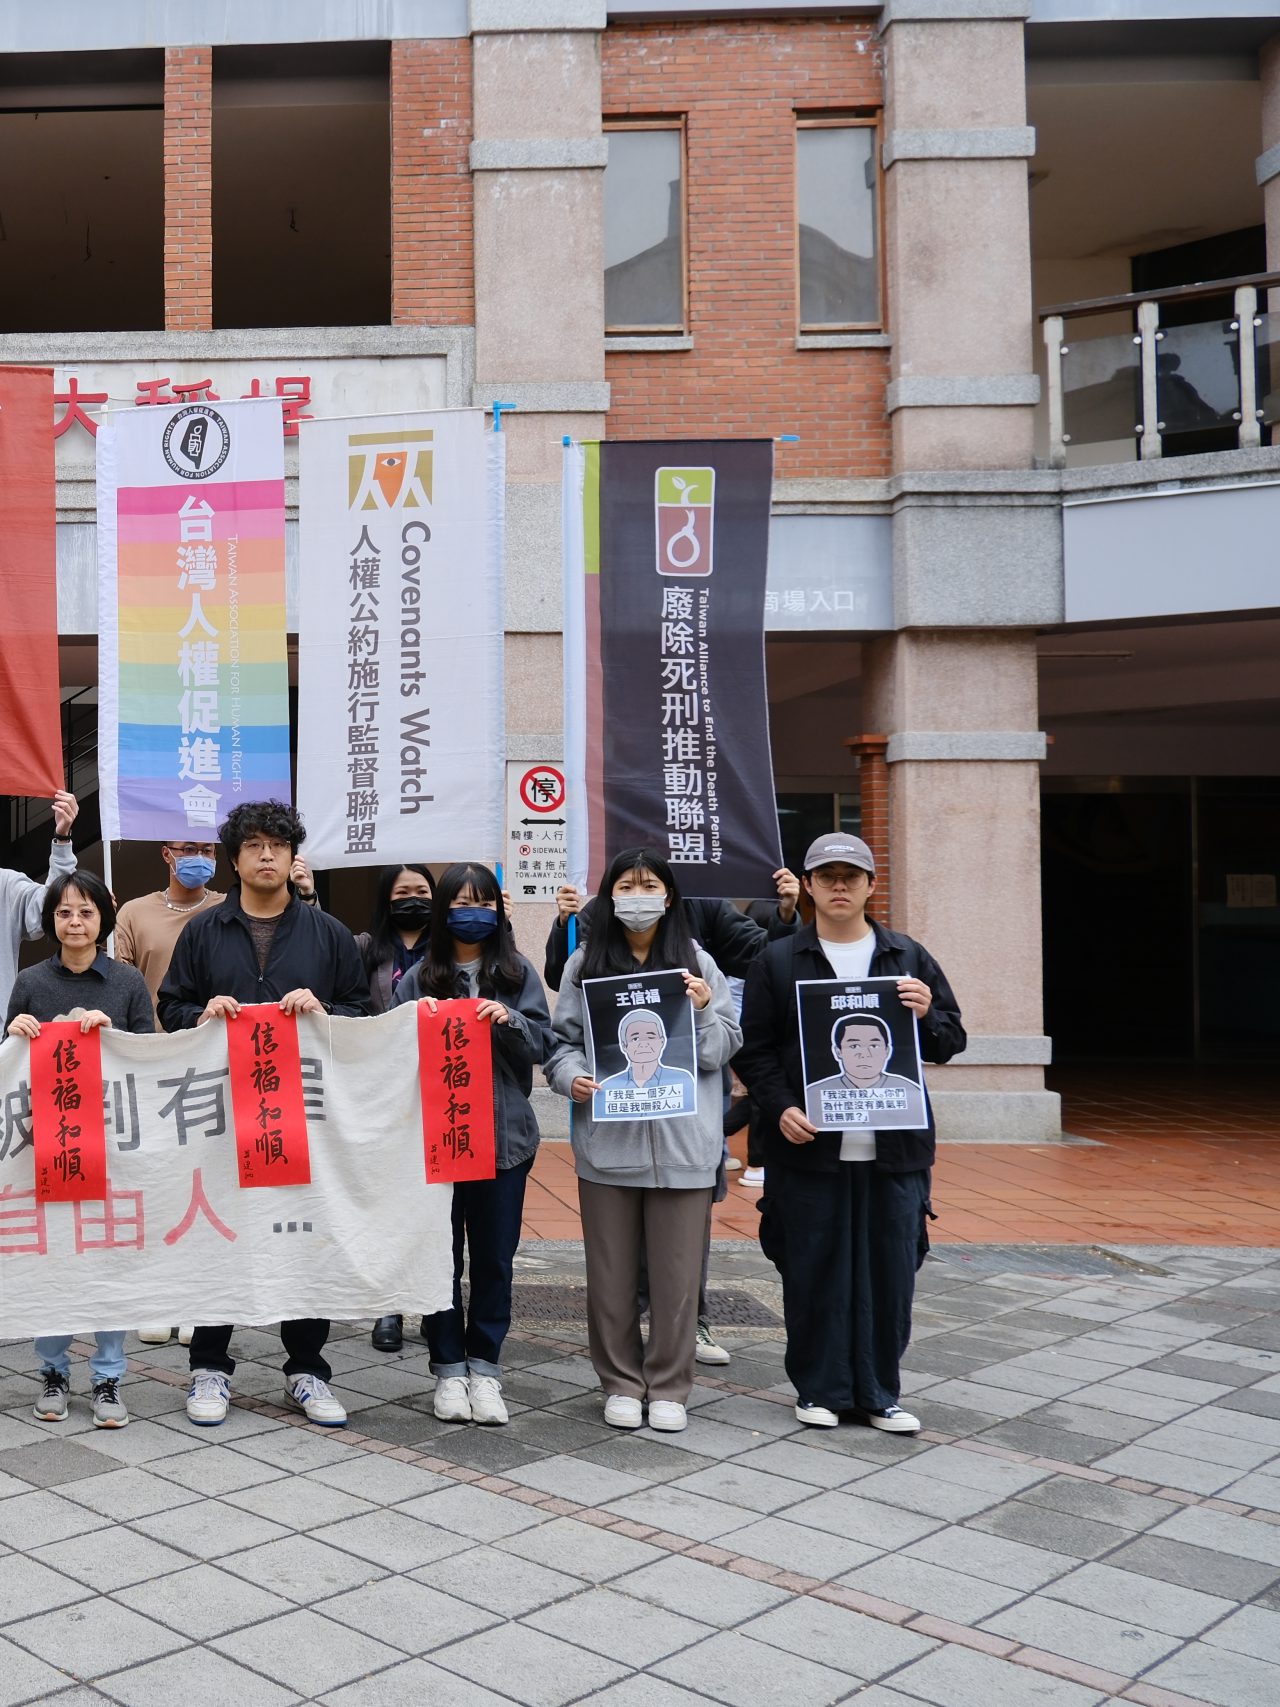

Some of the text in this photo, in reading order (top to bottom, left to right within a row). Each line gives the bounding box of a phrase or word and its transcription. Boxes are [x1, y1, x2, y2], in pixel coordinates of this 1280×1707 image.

[163, 421, 175, 447] RIGHTS
[164, 449, 180, 473] HUMAN
[195, 446, 229, 478] ASSOCIATION
[216, 417, 229, 444] TAIWAN
[176, 495, 223, 829] 台灣人權促進會
[227, 533, 243, 792] TAIWAN ASSOCIATION FOR HUMAN RIGHTS
[343, 524, 382, 855] 人權公約施行監督聯盟
[400, 520, 435, 815] Covenants Watch
[661, 585, 708, 865] 廢除死刑推動聯盟
[698, 587, 723, 865] Taiwan Alliance to End the Death Penalty
[511, 830, 567, 841] 騎樓·人行
[531, 777, 557, 803] 停
[615, 989, 661, 1007] 王信福
[830, 993, 880, 1010] 邱和順
[51, 1039, 86, 1183] 信福和順
[251, 1022, 289, 1166] 信福和順
[440, 1016, 474, 1160] 信福和順
